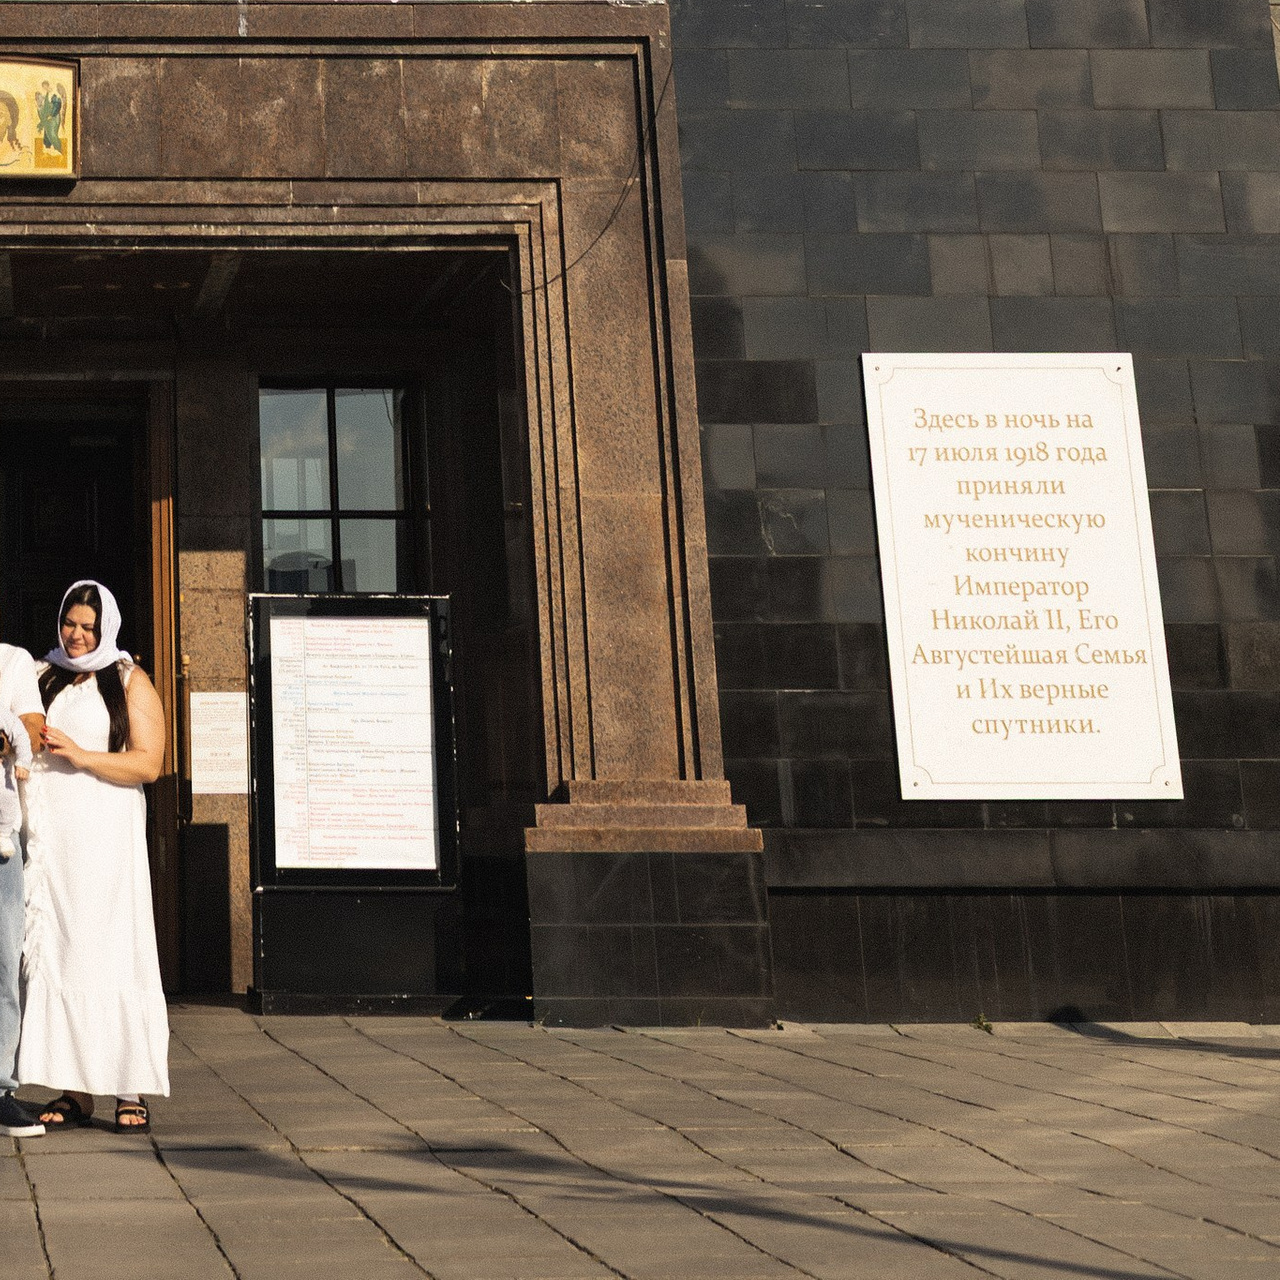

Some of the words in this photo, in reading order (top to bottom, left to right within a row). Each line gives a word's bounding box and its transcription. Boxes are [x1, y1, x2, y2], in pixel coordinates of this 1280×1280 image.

[913, 407, 979, 433] Здесь
[986, 414, 998, 429] в
[1004, 413, 1060, 429] ночь
[1066, 413, 1094, 429] на
[907, 445, 926, 467] 17
[934, 446, 998, 462] июля
[1005, 442, 1050, 467] 1918
[1056, 446, 1108, 465] года
[957, 478, 1065, 501] приняли
[923, 512, 1106, 534] мученическую
[965, 546, 1070, 568] кончину
[954, 575, 1090, 601] Император
[931, 608, 1040, 631] Николай
[1078, 609, 1119, 631] Его
[911, 644, 1068, 670] Августейшая
[1075, 644, 1148, 665] Семья
[956, 682, 972, 699] и
[979, 677, 1011, 699] Их
[1019, 682, 1109, 705] верные
[971, 717, 1102, 741] спутники.
